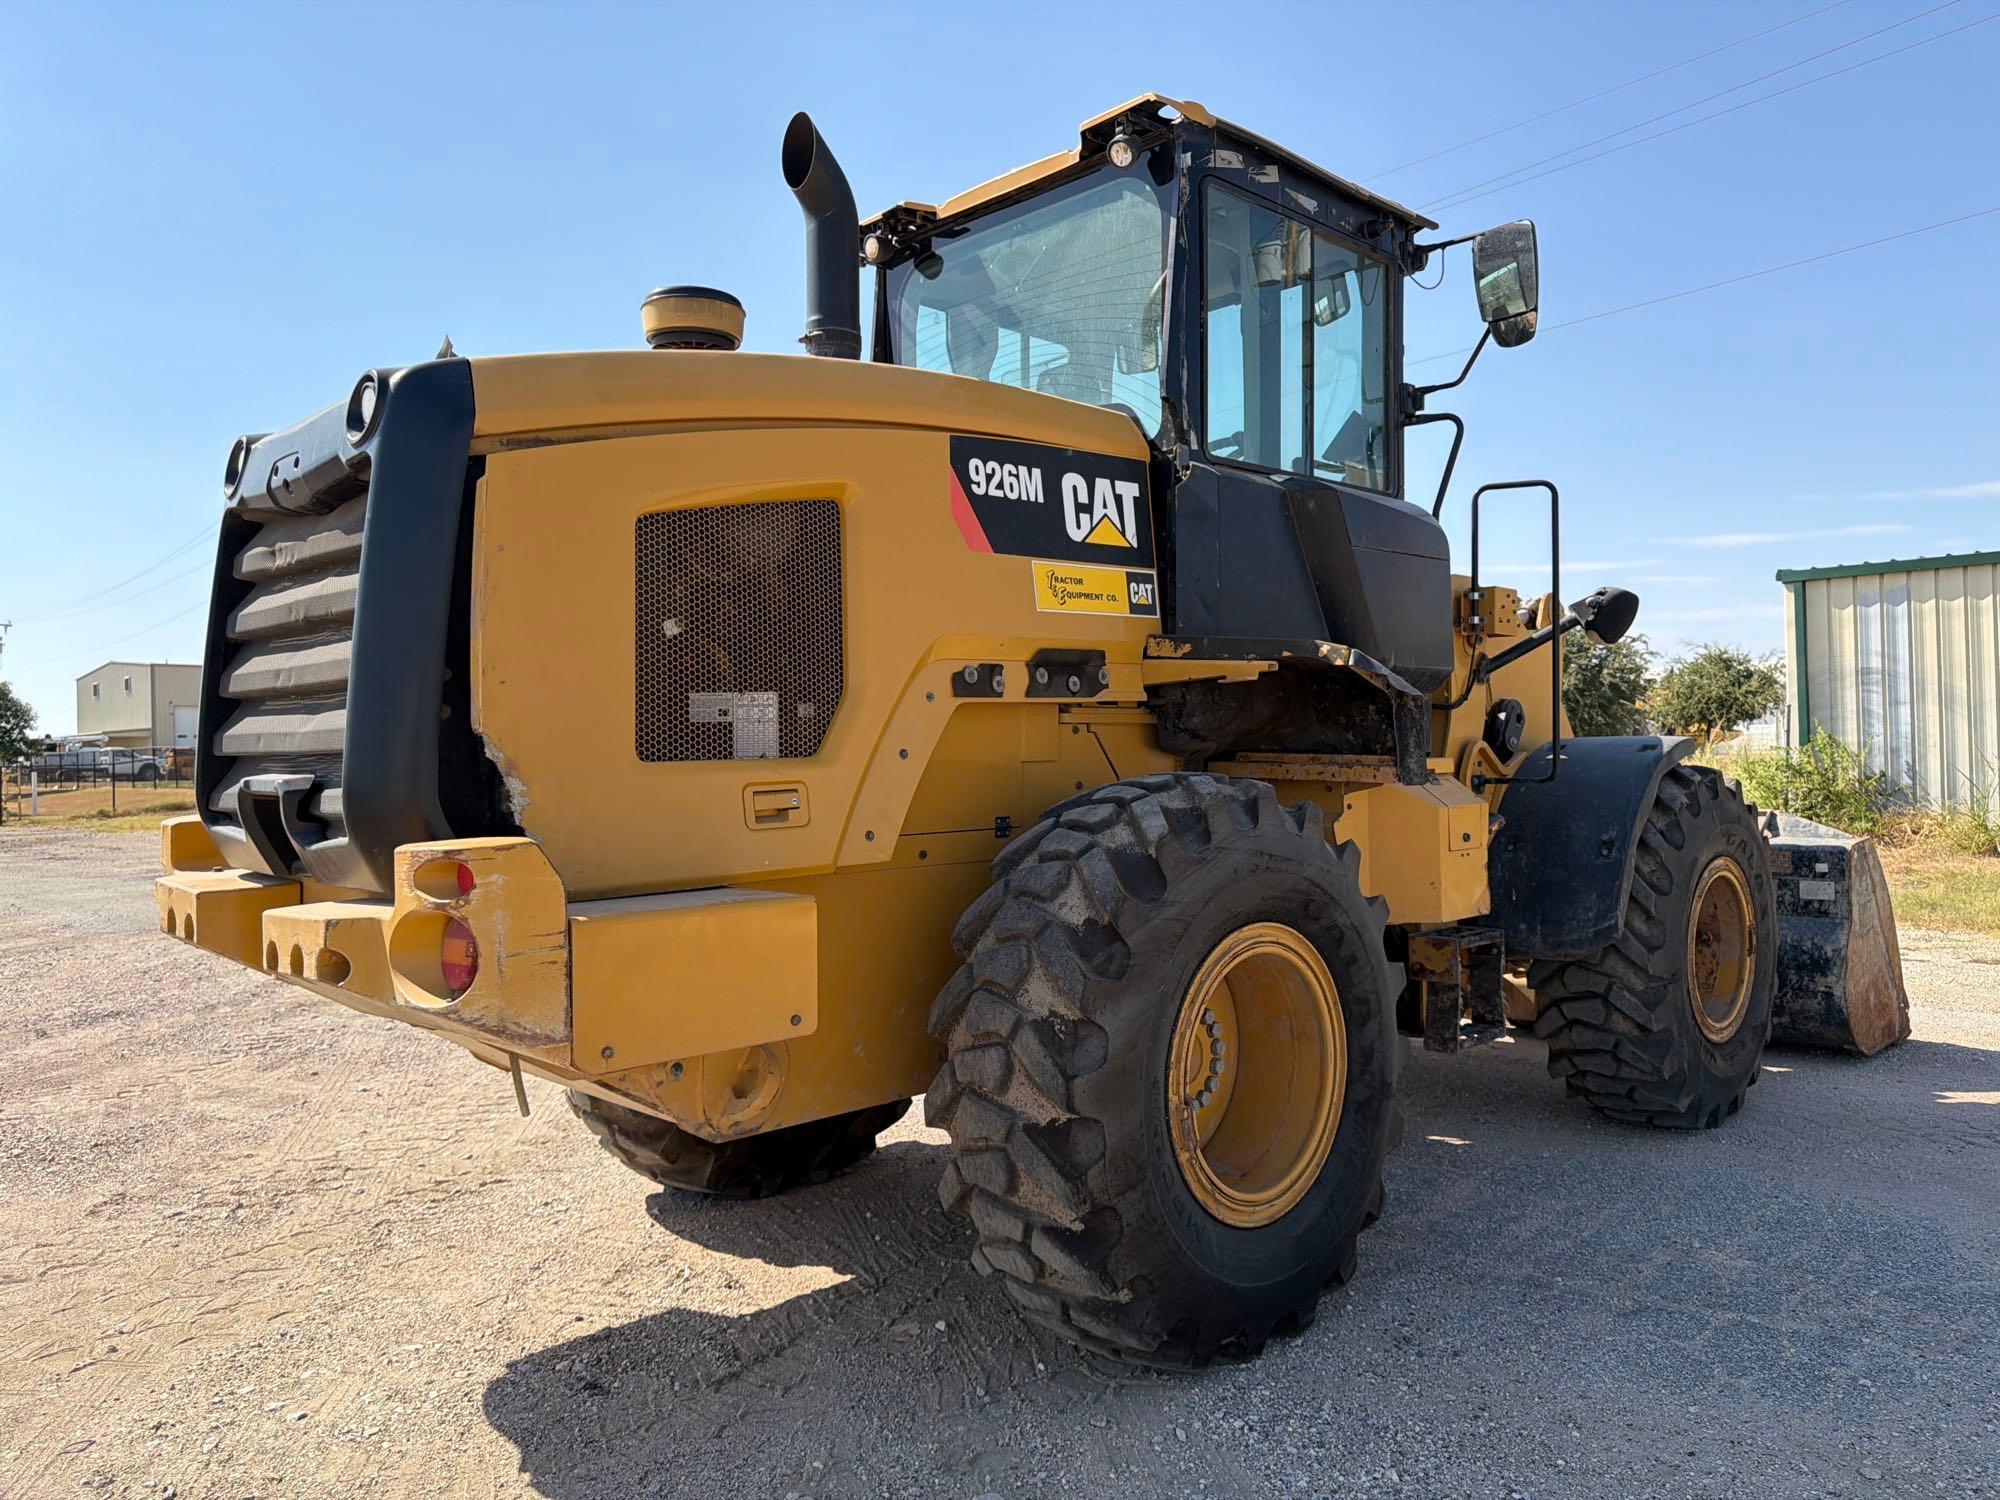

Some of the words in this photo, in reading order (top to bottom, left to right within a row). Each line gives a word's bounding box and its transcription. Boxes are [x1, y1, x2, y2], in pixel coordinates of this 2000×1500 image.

[968, 457, 1045, 504] 926M
[1061, 472, 1140, 549] CAT
[1046, 570, 1084, 590] TRACTOR
[1057, 586, 1104, 606] EQUIPMENT
[1107, 593, 1119, 603] CO.
[1129, 582, 1153, 605] CAT
